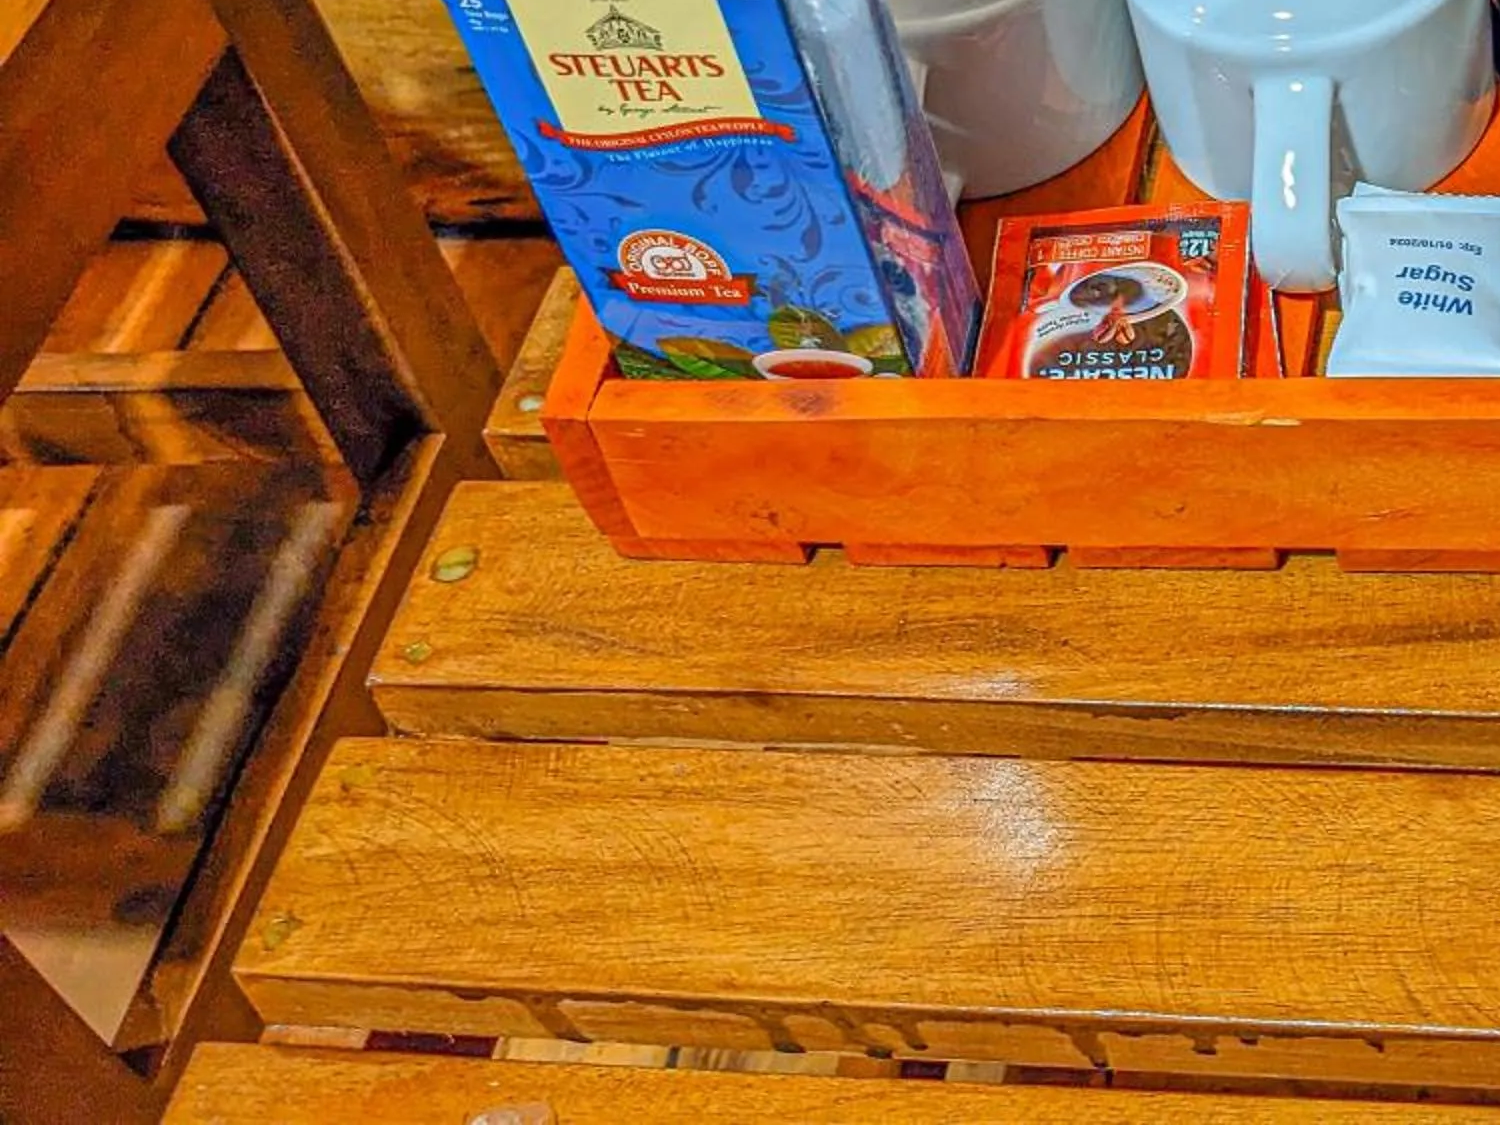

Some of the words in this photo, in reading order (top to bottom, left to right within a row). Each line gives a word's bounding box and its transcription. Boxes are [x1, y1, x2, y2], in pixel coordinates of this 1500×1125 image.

[549, 53, 725, 77] STEUARTS
[609, 78, 683, 101] TEA
[1395, 264, 1475, 292] Sugar
[627, 281, 705, 298] Premium
[710, 285, 743, 299] Tea
[1397, 290, 1473, 316] White
[1058, 348, 1164, 366] CLASSIC
